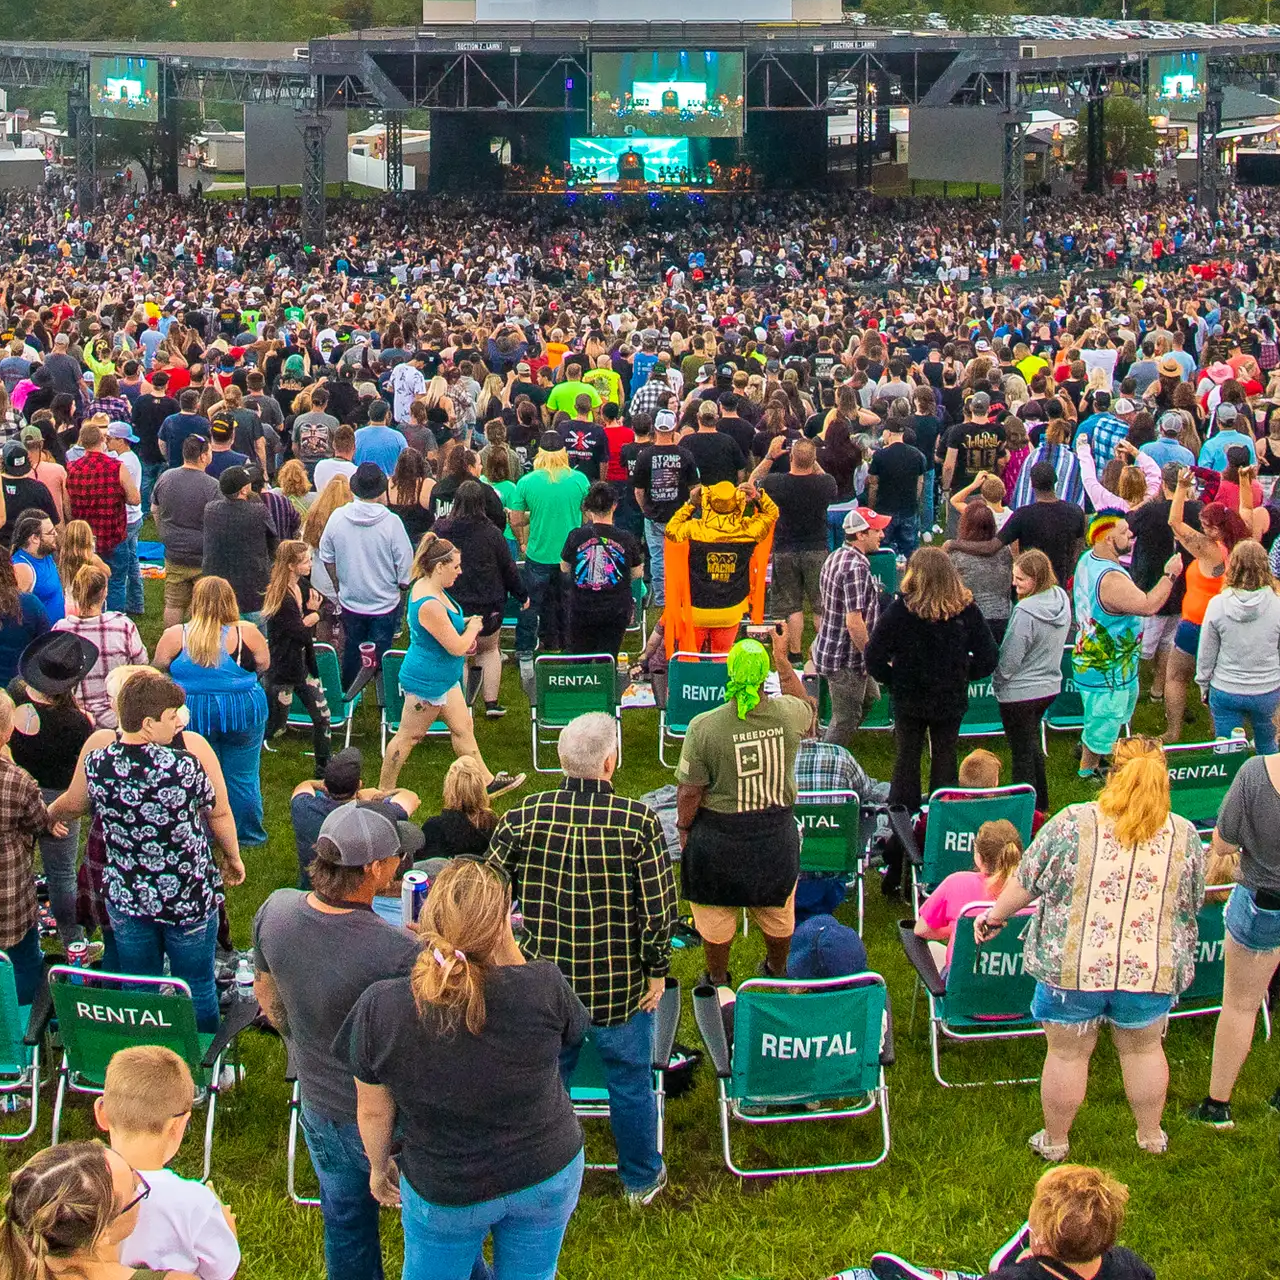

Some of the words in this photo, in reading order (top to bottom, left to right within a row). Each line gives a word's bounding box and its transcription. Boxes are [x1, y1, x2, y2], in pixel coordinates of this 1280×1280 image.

[457, 42, 478, 50] SECTION
[486, 42, 500, 50] LAWN
[833, 41, 853, 49] SECTION
[652, 454, 681, 463] STOMP
[549, 674, 601, 686] RENTAL
[682, 684, 726, 701] RENTA
[967, 683, 995, 698] NTA
[733, 727, 784, 743] FREEDOM
[1167, 763, 1228, 781] RENTAL
[793, 815, 840, 829] NTAL
[945, 831, 975, 852] REN
[1193, 940, 1225, 963] ENT
[972, 951, 1026, 976] RENT
[76, 1001, 173, 1027] RENTAL
[761, 1031, 857, 1060] RENTAL
